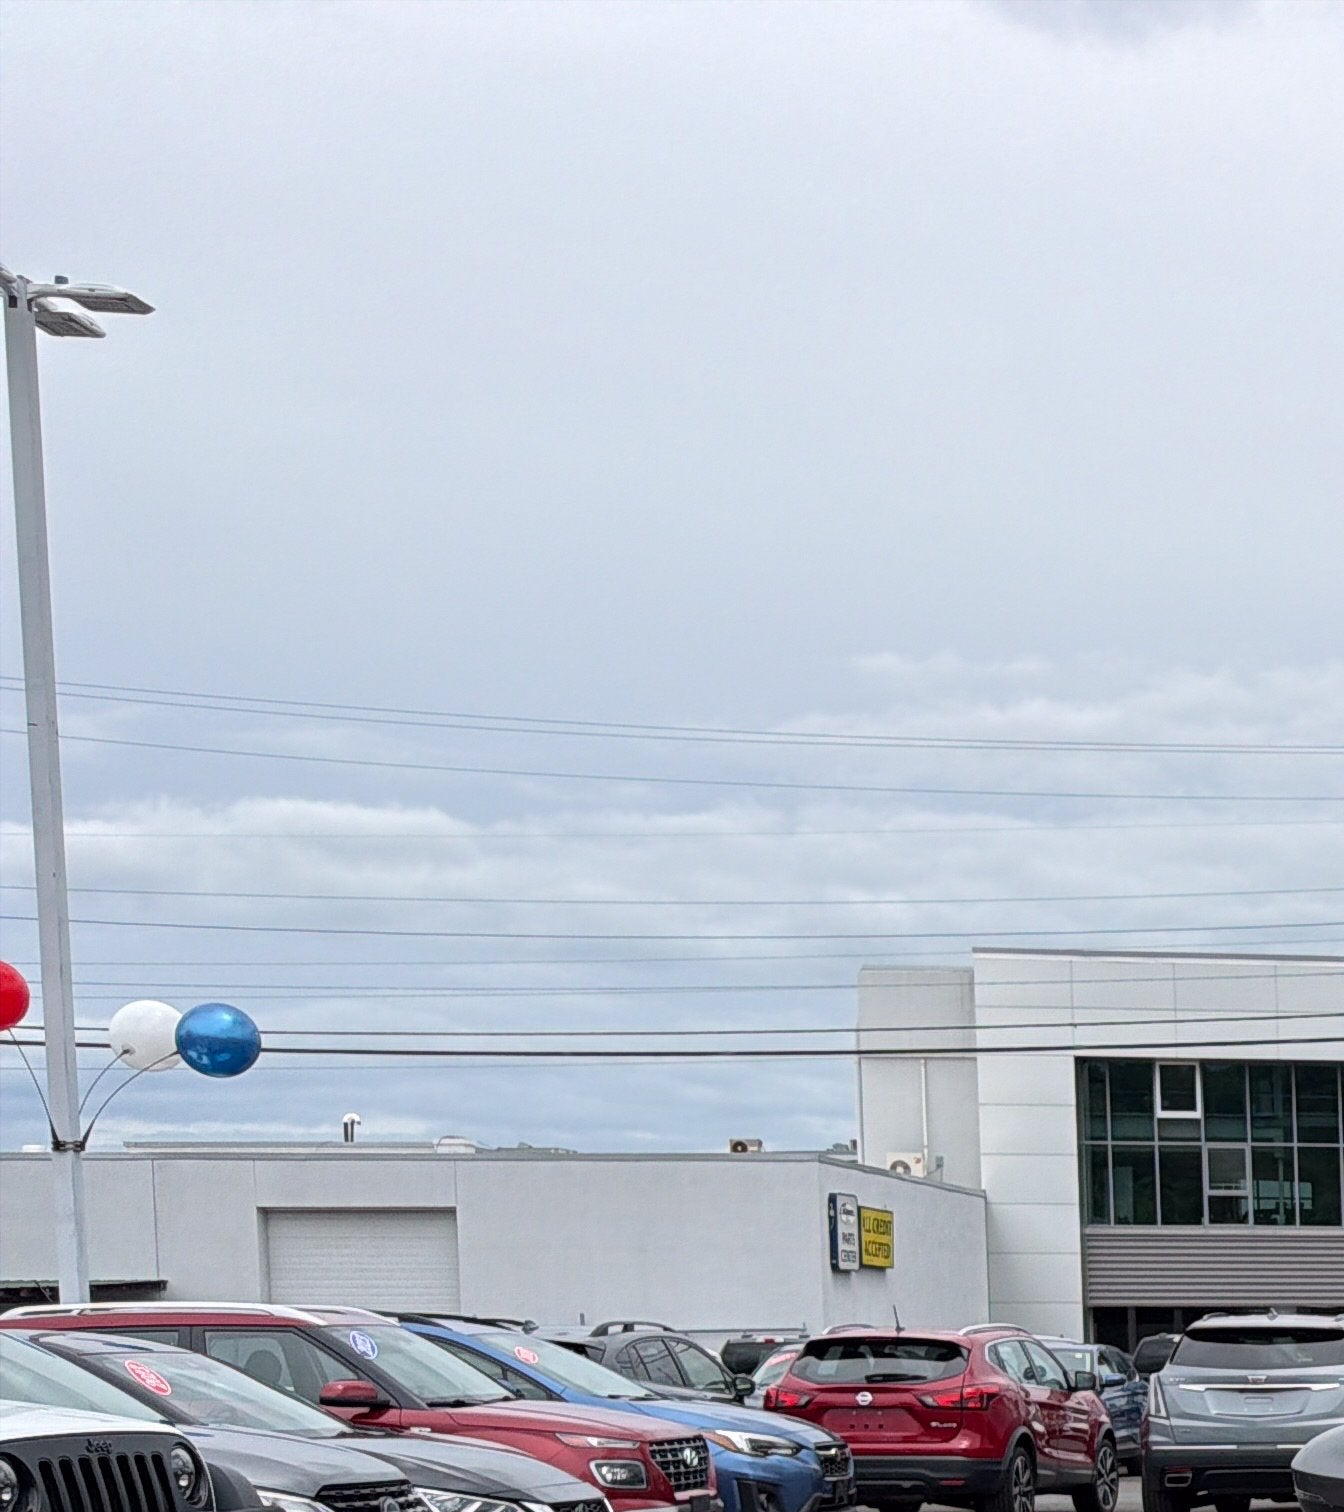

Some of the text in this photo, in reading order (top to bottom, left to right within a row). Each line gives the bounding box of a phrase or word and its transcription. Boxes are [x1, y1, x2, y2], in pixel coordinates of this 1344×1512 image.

[872, 1217, 892, 1236] CREDIT
[864, 1240, 891, 1259] ACCEPTED
[85, 1438, 112, 1454] Jeep
